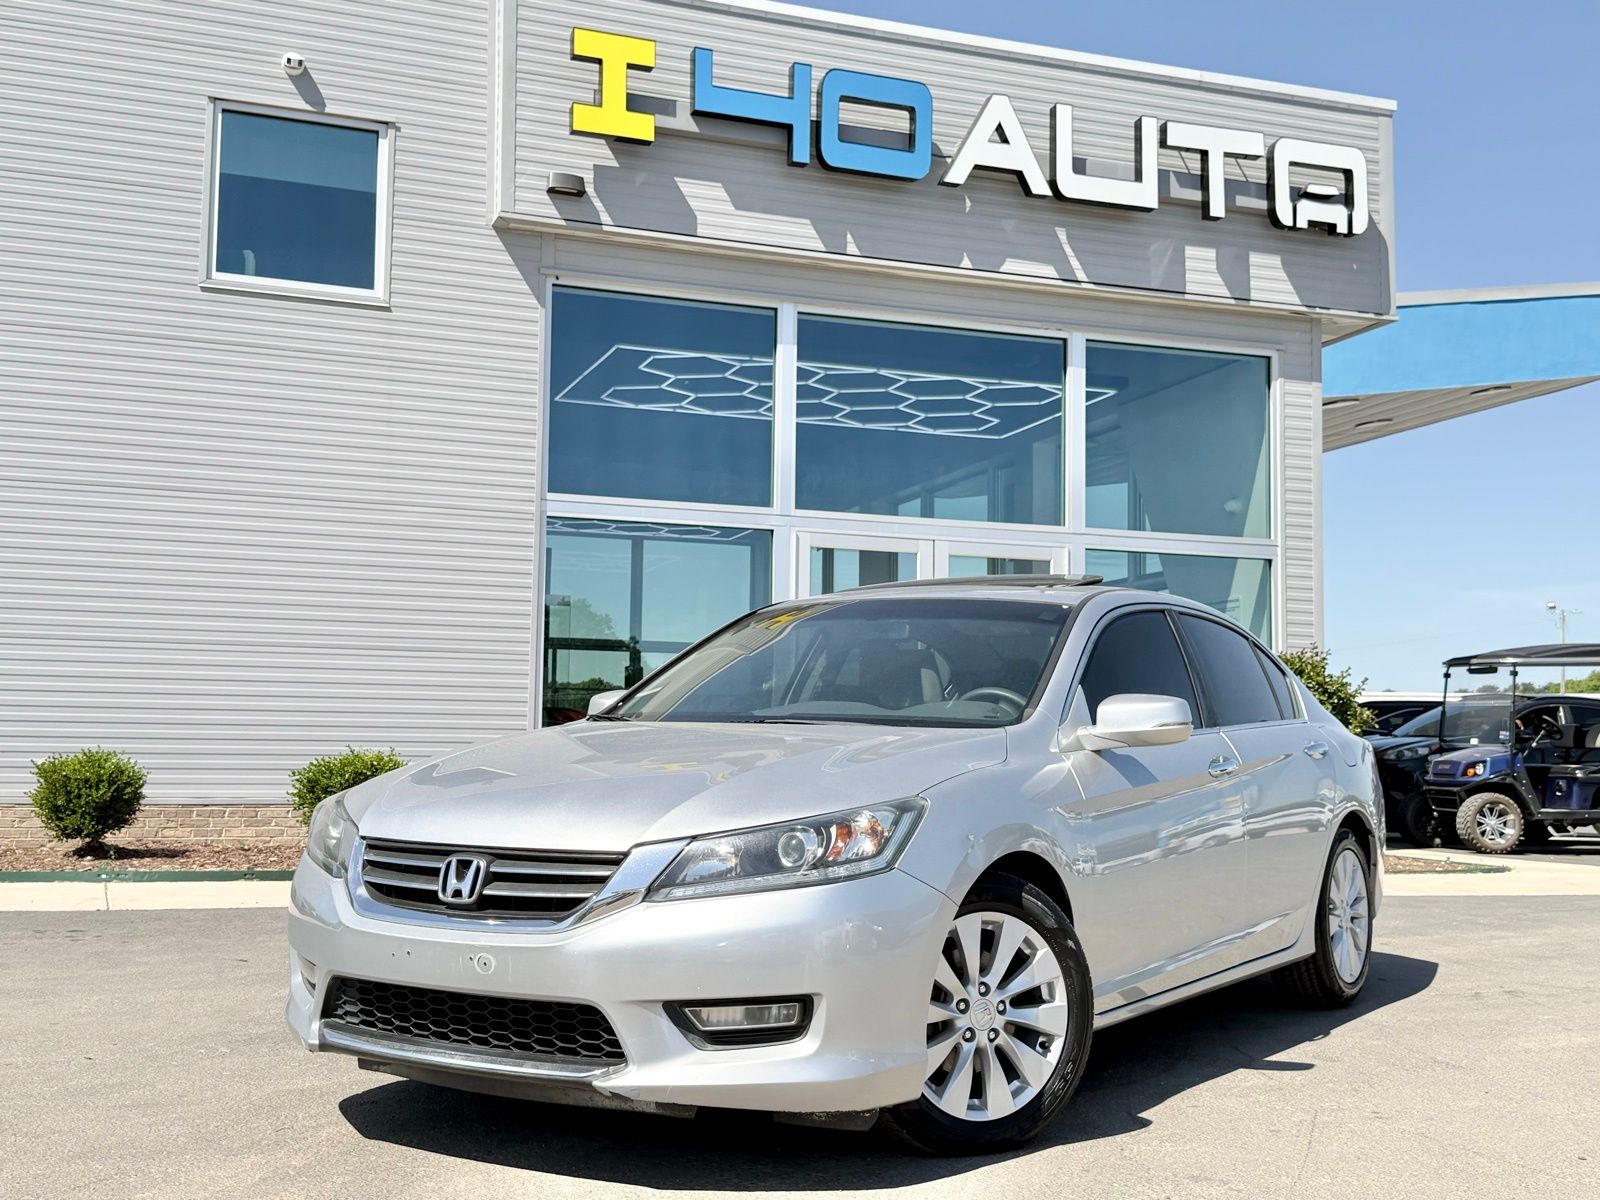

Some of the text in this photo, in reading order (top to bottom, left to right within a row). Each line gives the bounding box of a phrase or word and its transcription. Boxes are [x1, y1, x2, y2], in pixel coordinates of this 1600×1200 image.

[571, 27, 1368, 236] I 40 AUTO
